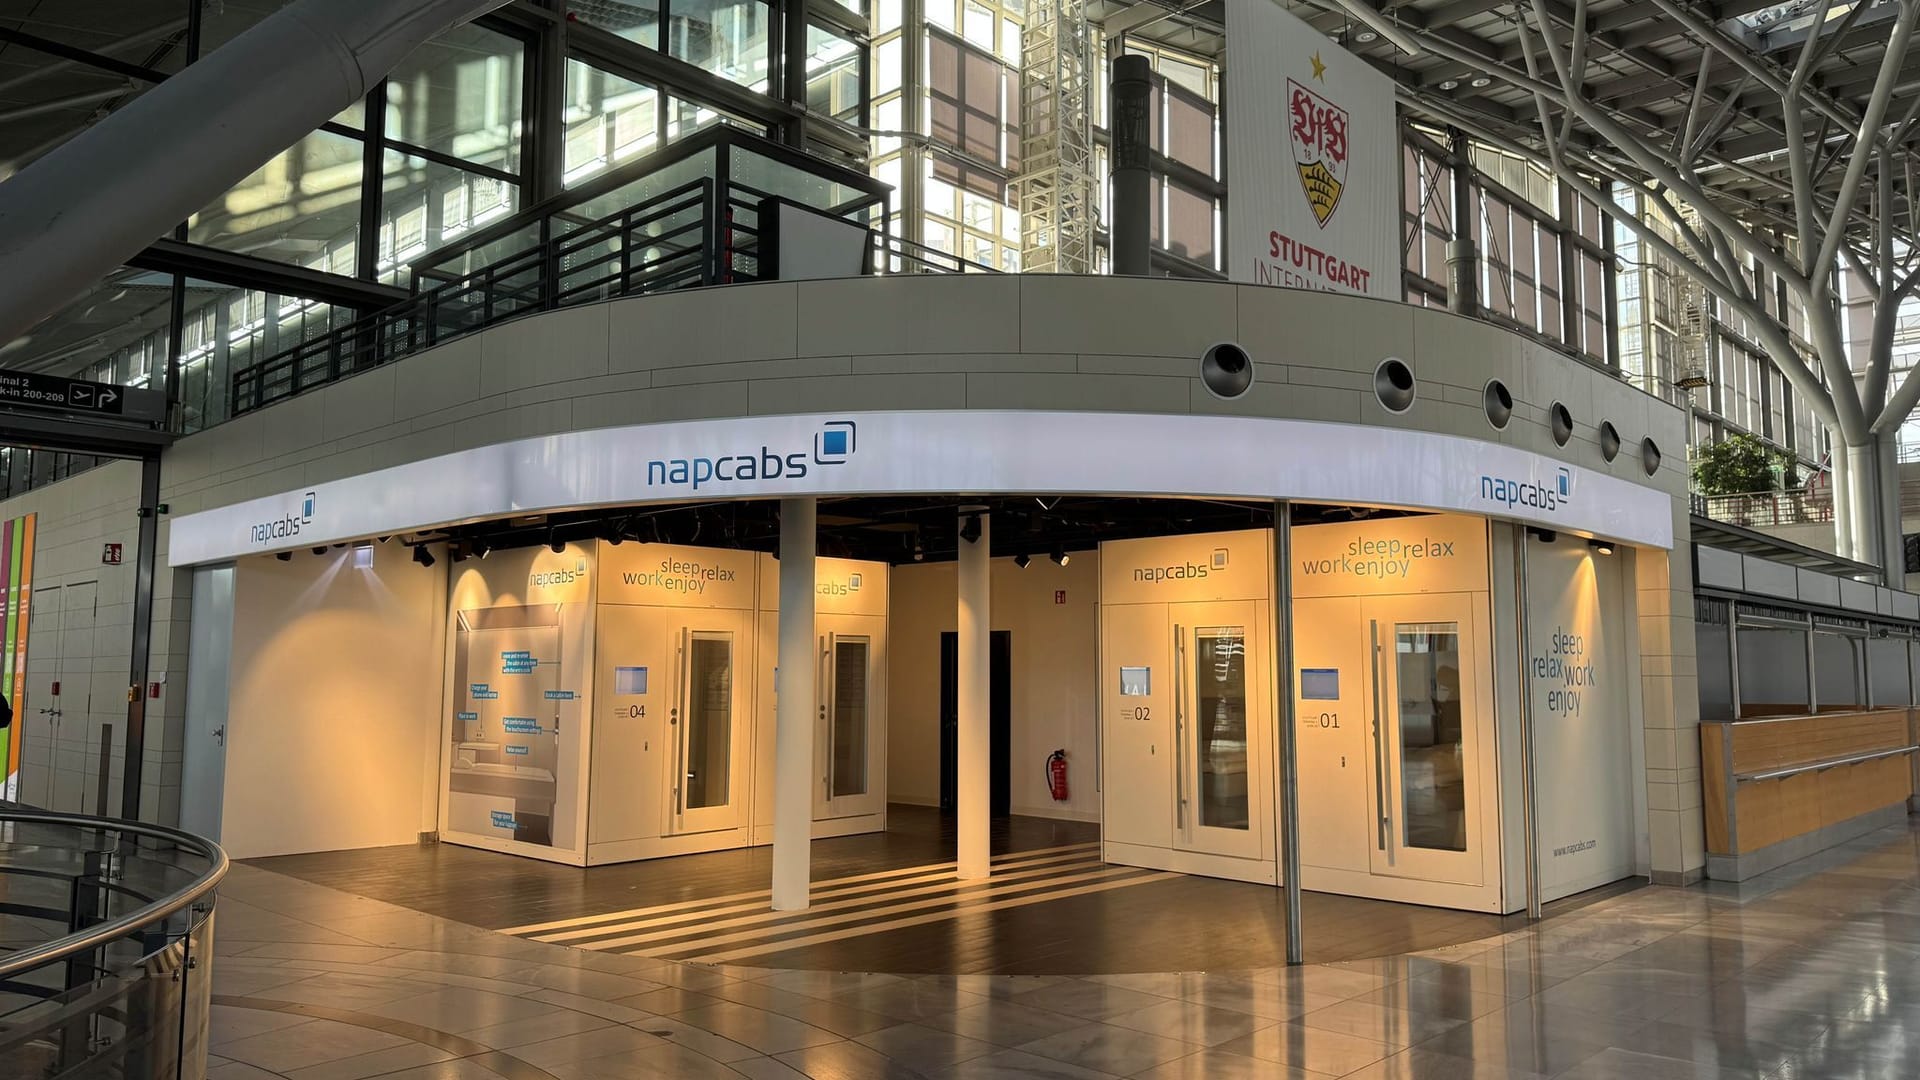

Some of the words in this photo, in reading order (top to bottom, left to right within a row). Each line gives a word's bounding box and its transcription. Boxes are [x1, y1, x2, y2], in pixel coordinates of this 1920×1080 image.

[1269, 231, 1370, 293] STUTTGART
[22, 378, 30, 387] 2
[23, 389, 65, 402] 200-209
[647, 446, 807, 490] napcabs
[1481, 476, 1556, 511] napcabs
[251, 512, 300, 546] napcabs
[1348, 536, 1401, 558] sleep
[1403, 537, 1455, 559] relax
[529, 568, 575, 588] napcabs
[660, 557, 700, 578] sleep
[701, 564, 735, 581] relax
[1134, 561, 1208, 584] napcabs
[1303, 553, 1352, 575] work
[1354, 556, 1410, 579] enjoy
[622, 569, 664, 586] work
[664, 576, 706, 594] enjoy
[815, 580, 848, 595] cabs
[1552, 625, 1584, 661] sleep
[1533, 648, 1563, 679] relax
[1564, 657, 1595, 687] work
[630, 704, 646, 719] 04
[1548, 683, 1581, 718] enjoy
[1134, 706, 1150, 721] 02
[1320, 713, 1340, 728] 01
